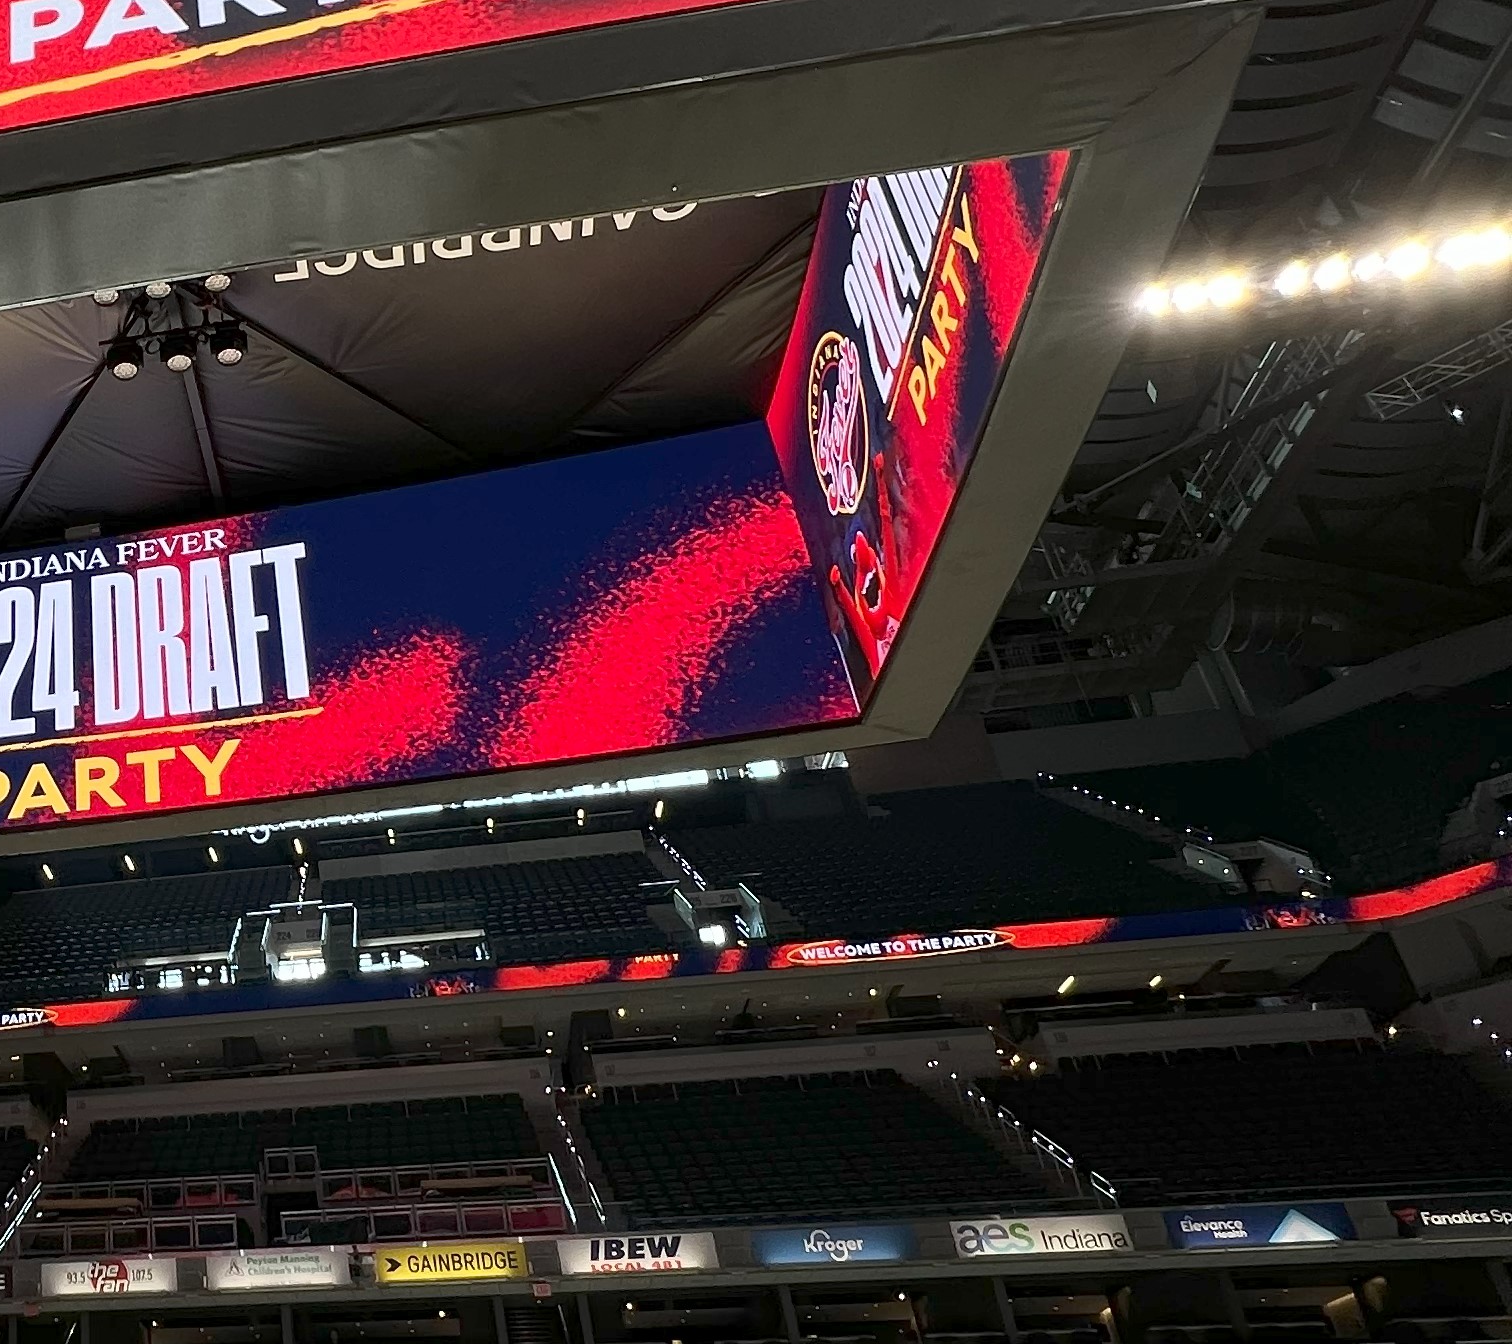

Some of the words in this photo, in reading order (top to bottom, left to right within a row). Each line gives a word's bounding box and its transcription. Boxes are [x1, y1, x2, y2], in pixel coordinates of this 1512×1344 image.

[843, 175, 922, 404] 2024
[907, 191, 980, 427] PARTY
[117, 526, 227, 566] FEVER
[90, 541, 310, 727] DRAFT
[800, 943, 881, 961] WELCOME
[882, 940, 906, 955] TO
[907, 936, 941, 952] THE
[942, 932, 997, 950] PARTY
[1, 1010, 45, 1026] PARTY
[1180, 1219, 1244, 1233] Elevance
[1420, 1210, 1488, 1226] Fanatics
[803, 1229, 864, 1262] Kroger
[956, 1222, 1035, 1254] aes
[1040, 1229, 1128, 1251] Indiana
[590, 1235, 682, 1262] IBEW
[88, 1262, 119, 1278] the
[246, 1257, 278, 1267] Peyton
[279, 1255, 320, 1264] Manning
[248, 1265, 292, 1276] Children's
[293, 1264, 332, 1275] Hospital
[407, 1250, 519, 1275] GAINBRIDGE
[66, 1271, 86, 1285] 93.5
[96, 1277, 129, 1293] fan
[131, 1269, 153, 1282] 107.5
